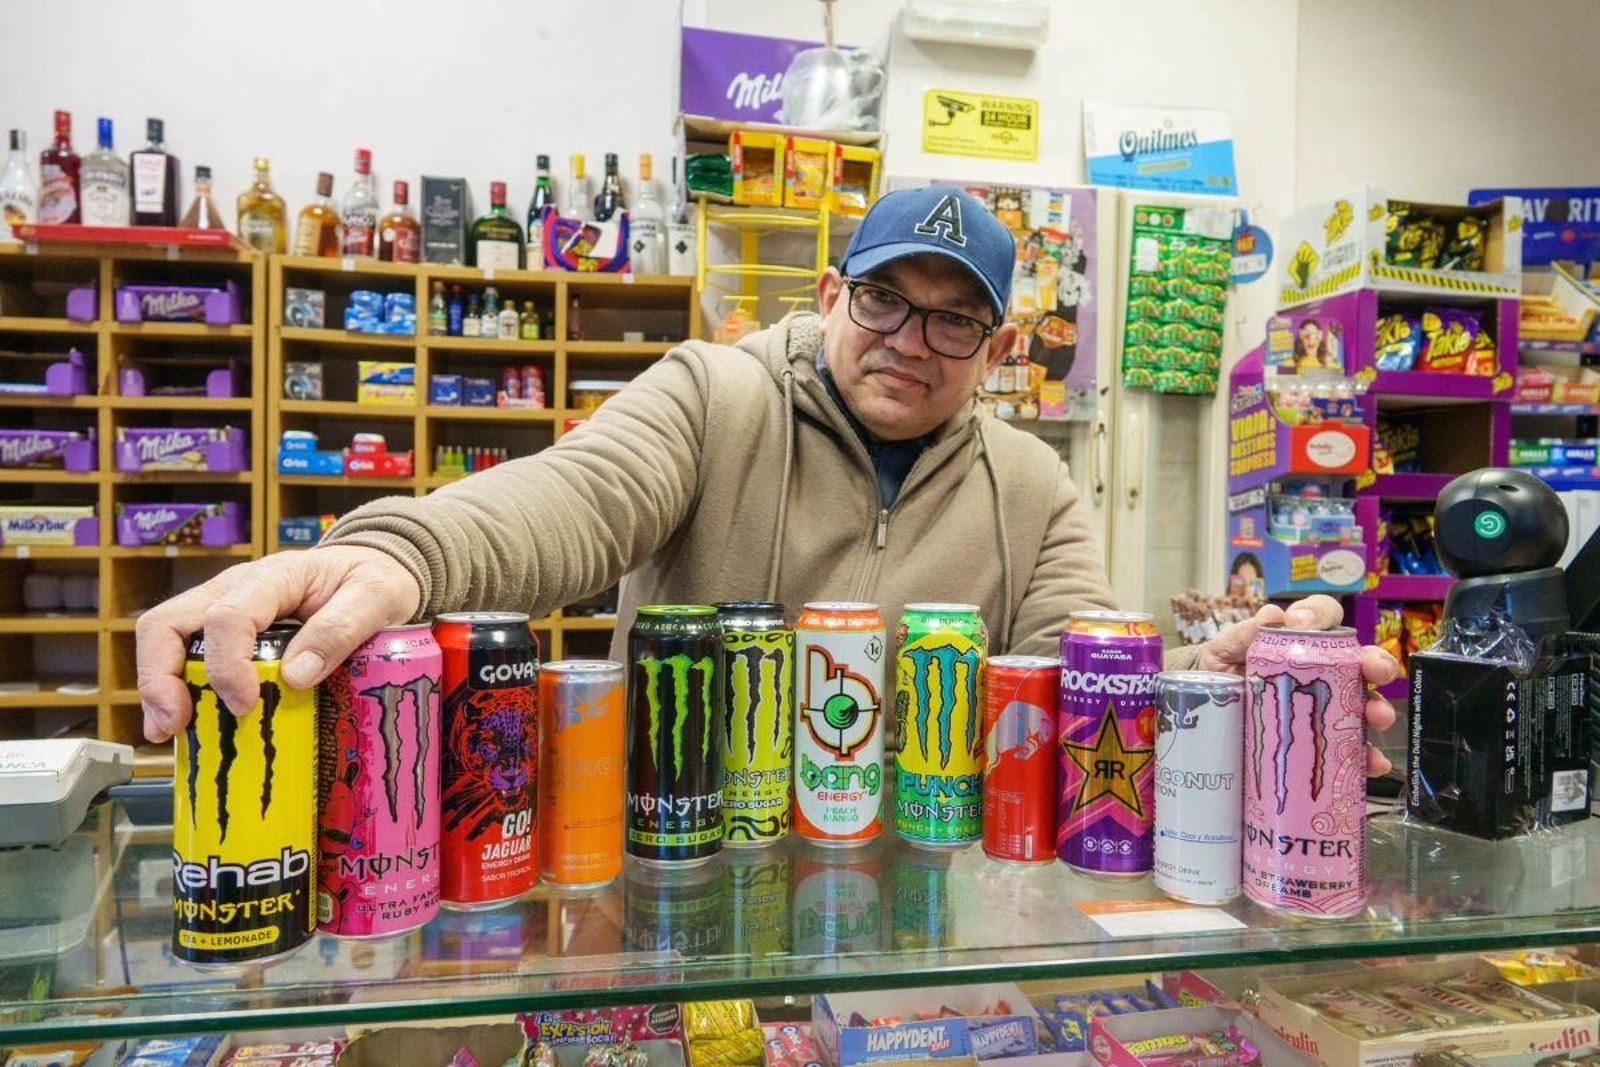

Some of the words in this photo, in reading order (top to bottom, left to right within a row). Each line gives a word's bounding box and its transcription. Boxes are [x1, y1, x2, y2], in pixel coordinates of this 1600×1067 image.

[726, 73, 783, 110] Mil
[1119, 128, 1199, 162] Quilmes
[914, 195, 967, 248] A
[141, 292, 201, 315] Milka
[0, 433, 55, 462] Milka
[136, 433, 195, 461] Milka
[132, 508, 178, 528] Milka
[1090, 653, 1133, 661] GUAYABA
[480, 661, 535, 684] GOYA
[724, 767, 790, 789] ONSTER
[800, 752, 881, 797] bang
[747, 797, 783, 809] SUGAR
[816, 790, 864, 802] ENERGY
[501, 808, 532, 840] GO!
[637, 817, 717, 830] ENERGY
[480, 834, 532, 861] JAGUAR
[631, 828, 667, 844] ZERO
[1246, 821, 1353, 859] ONSTER
[172, 848, 310, 893] Rehab
[1261, 870, 1354, 891] STRAWBERRY
[1255, 877, 1313, 899] DREAMS
[173, 890, 296, 925] MONSTER
[357, 899, 407, 913] ULTRA
[382, 904, 420, 921] RUBY
[210, 930, 273, 947] LEMONADE
[867, 1026, 946, 1052] HAPPYDENT
[974, 1022, 1020, 1047] HAPPYDENT
